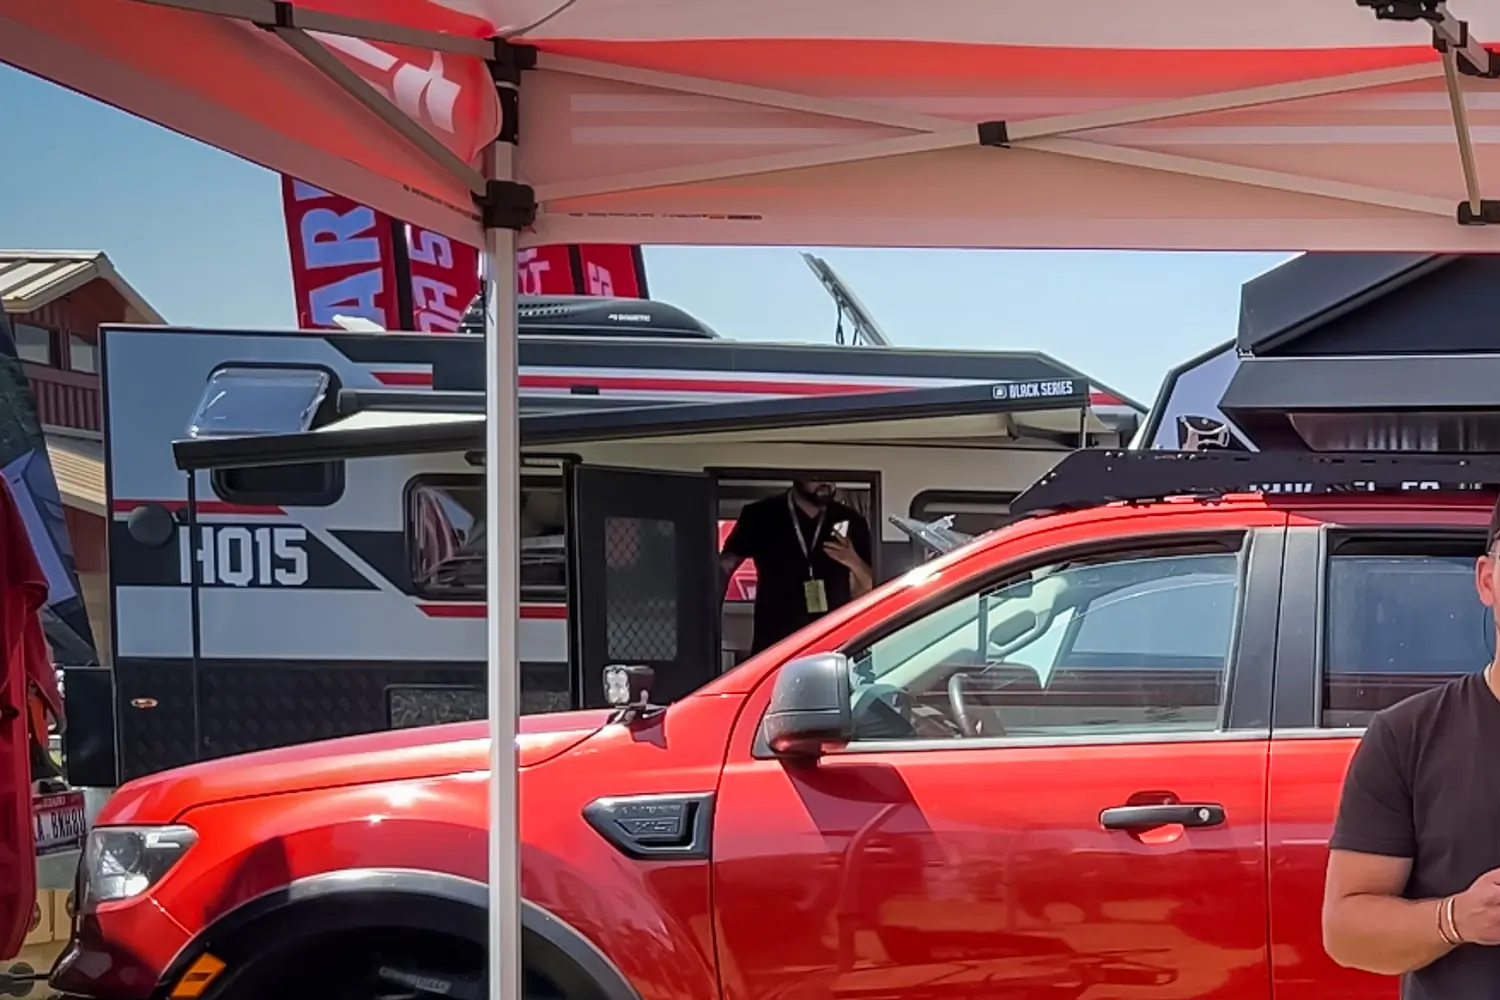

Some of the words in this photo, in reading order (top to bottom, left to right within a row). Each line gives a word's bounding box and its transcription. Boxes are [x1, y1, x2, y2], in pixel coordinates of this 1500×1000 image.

[1009, 383, 1040, 399] BLACK
[1040, 380, 1073, 396] SERIES
[179, 525, 309, 587] HQ15
